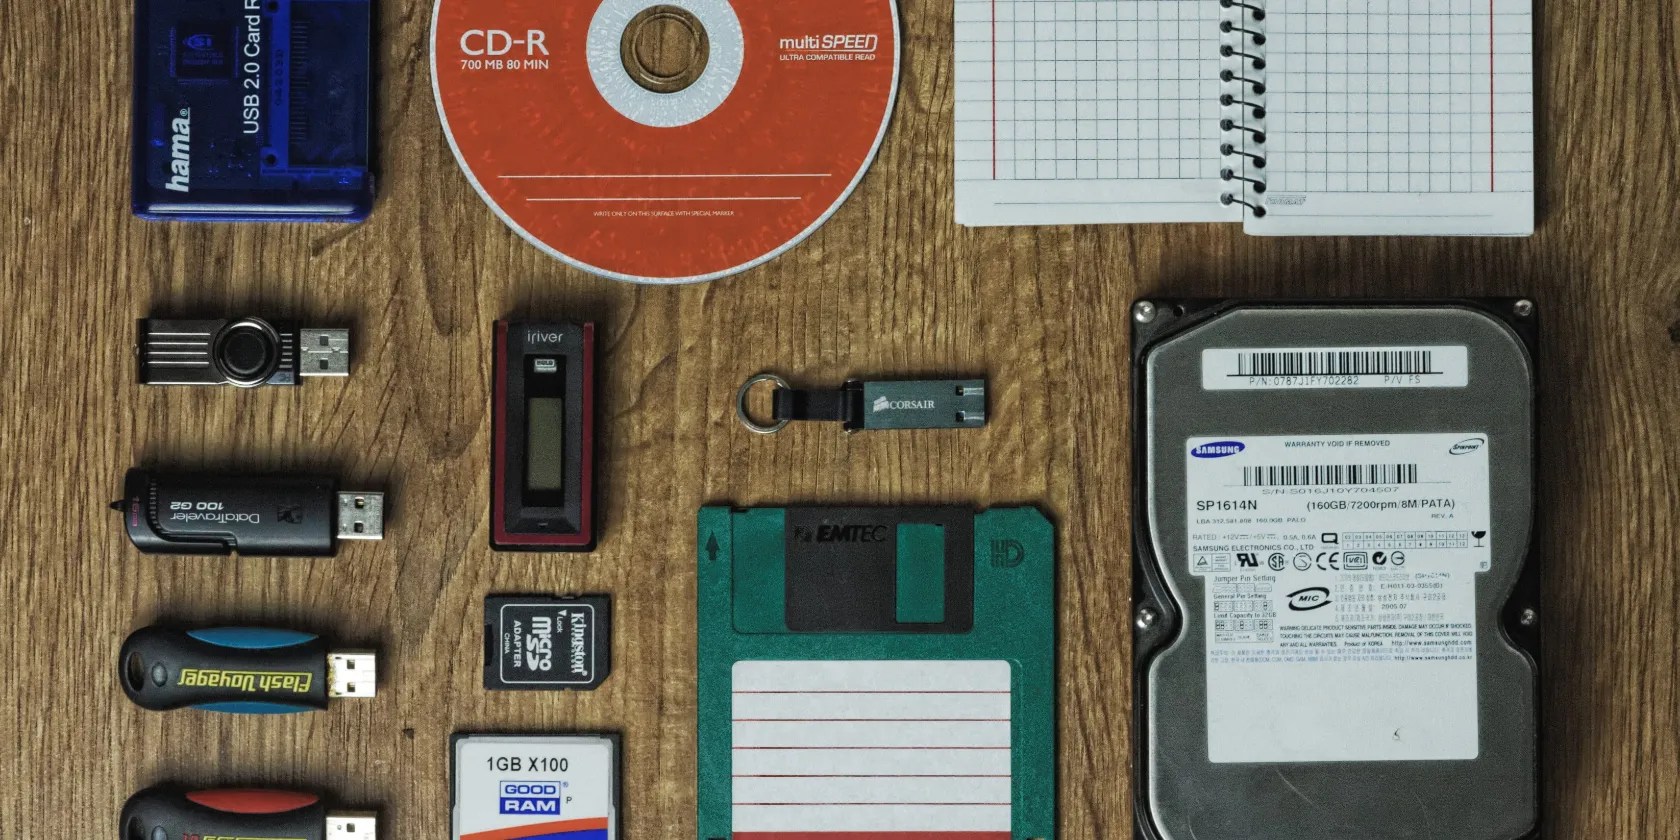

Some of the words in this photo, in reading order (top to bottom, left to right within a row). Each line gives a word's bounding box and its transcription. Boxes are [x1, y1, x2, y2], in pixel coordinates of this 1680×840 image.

[244, 15, 261, 57] Card
[460, 29, 550, 56] CD-R
[780, 35, 820, 49] multi
[821, 34, 878, 52] SPEED
[780, 53, 804, 61] ULTRA
[805, 53, 853, 61] COMPATIBLE
[855, 53, 876, 61] READ
[461, 60, 482, 70] 700
[485, 60, 504, 70] MB
[506, 60, 521, 70] 80
[524, 60, 549, 70] MIN
[243, 62, 260, 89] 2.0
[243, 94, 260, 134] USB
[165, 117, 190, 192] hama
[527, 330, 564, 344] iriver
[1384, 374, 1402, 384] P/V
[1409, 374, 1421, 383] FS
[890, 400, 935, 409] CORSAIR
[1196, 445, 1240, 454] SAMSUNG
[170, 502, 193, 510] G2
[196, 502, 225, 510] 100
[1196, 500, 1257, 511] SP1614N
[170, 512, 260, 524] DataTraveler
[816, 524, 888, 542] EMTEC
[513, 620, 522, 668] ADAPTER
[531, 616, 552, 671] micro
[570, 612, 587, 674] Kingston
[177, 668, 256, 692] Voyager
[259, 672, 313, 693] Flash
[487, 756, 522, 772] 1GB
[528, 757, 569, 772] X100
[504, 784, 556, 795] GOOD
[504, 800, 556, 812] RAM
[566, 796, 573, 804] P
